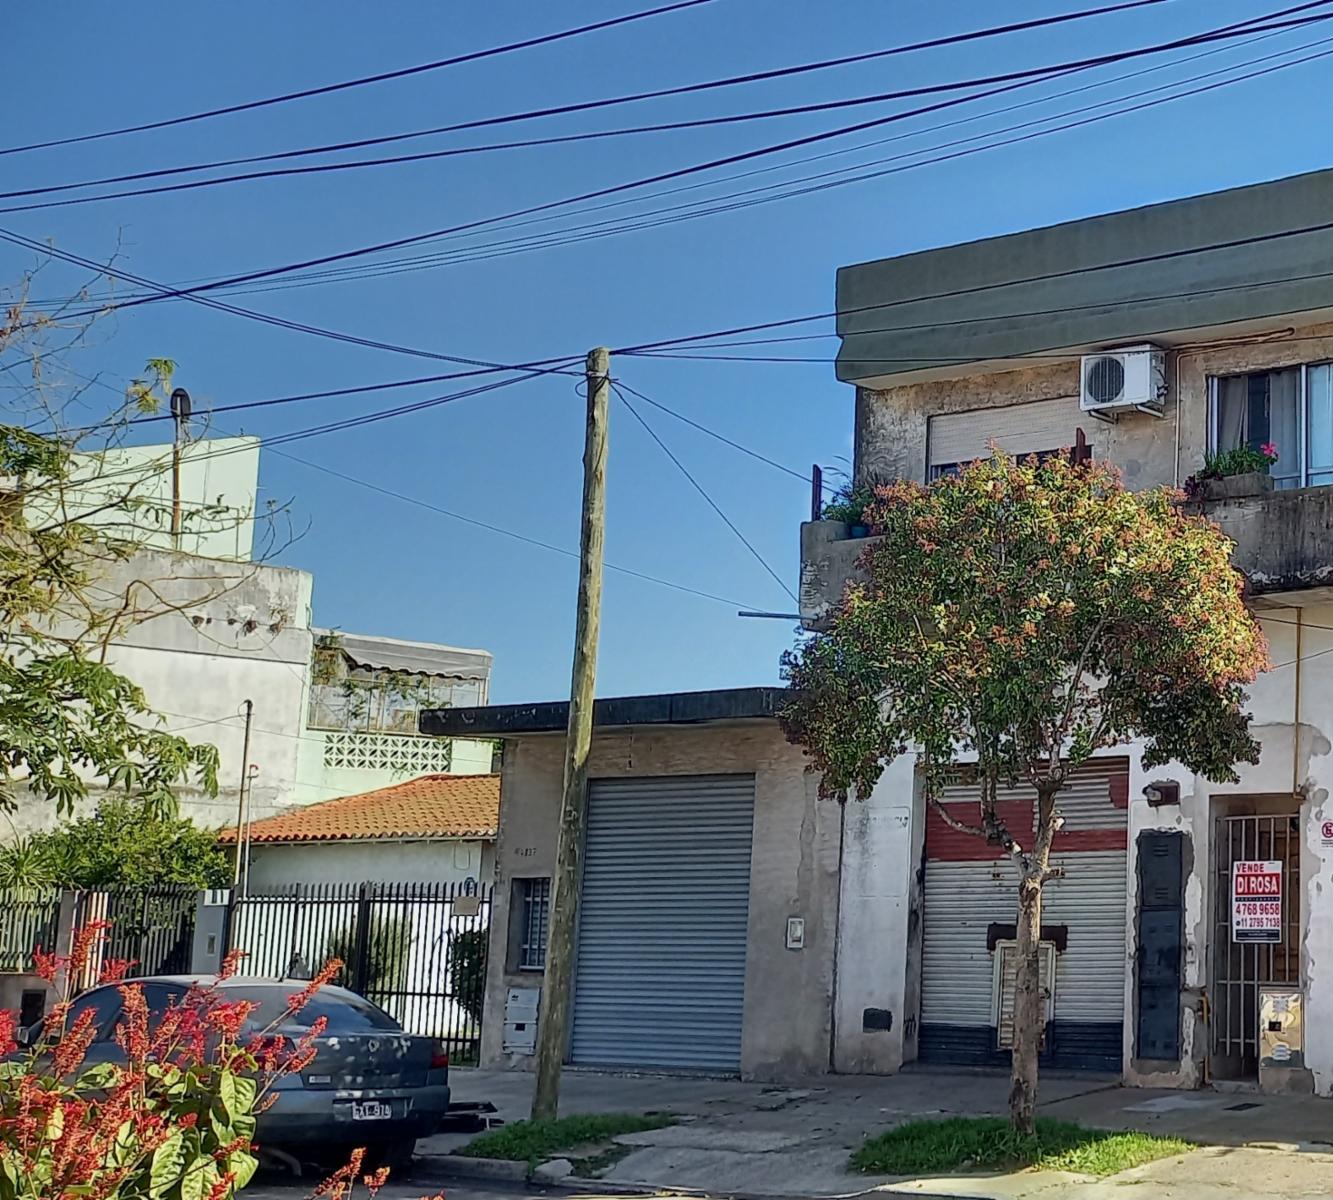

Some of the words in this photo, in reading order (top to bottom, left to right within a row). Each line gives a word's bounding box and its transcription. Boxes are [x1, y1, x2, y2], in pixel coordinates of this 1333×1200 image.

[1236, 863, 1264, 873] VENDE
[1237, 876, 1249, 893] DI
[1250, 875, 1278, 893] ROSA
[1235, 903, 1258, 915] 4768
[1259, 902, 1280, 915] 9658
